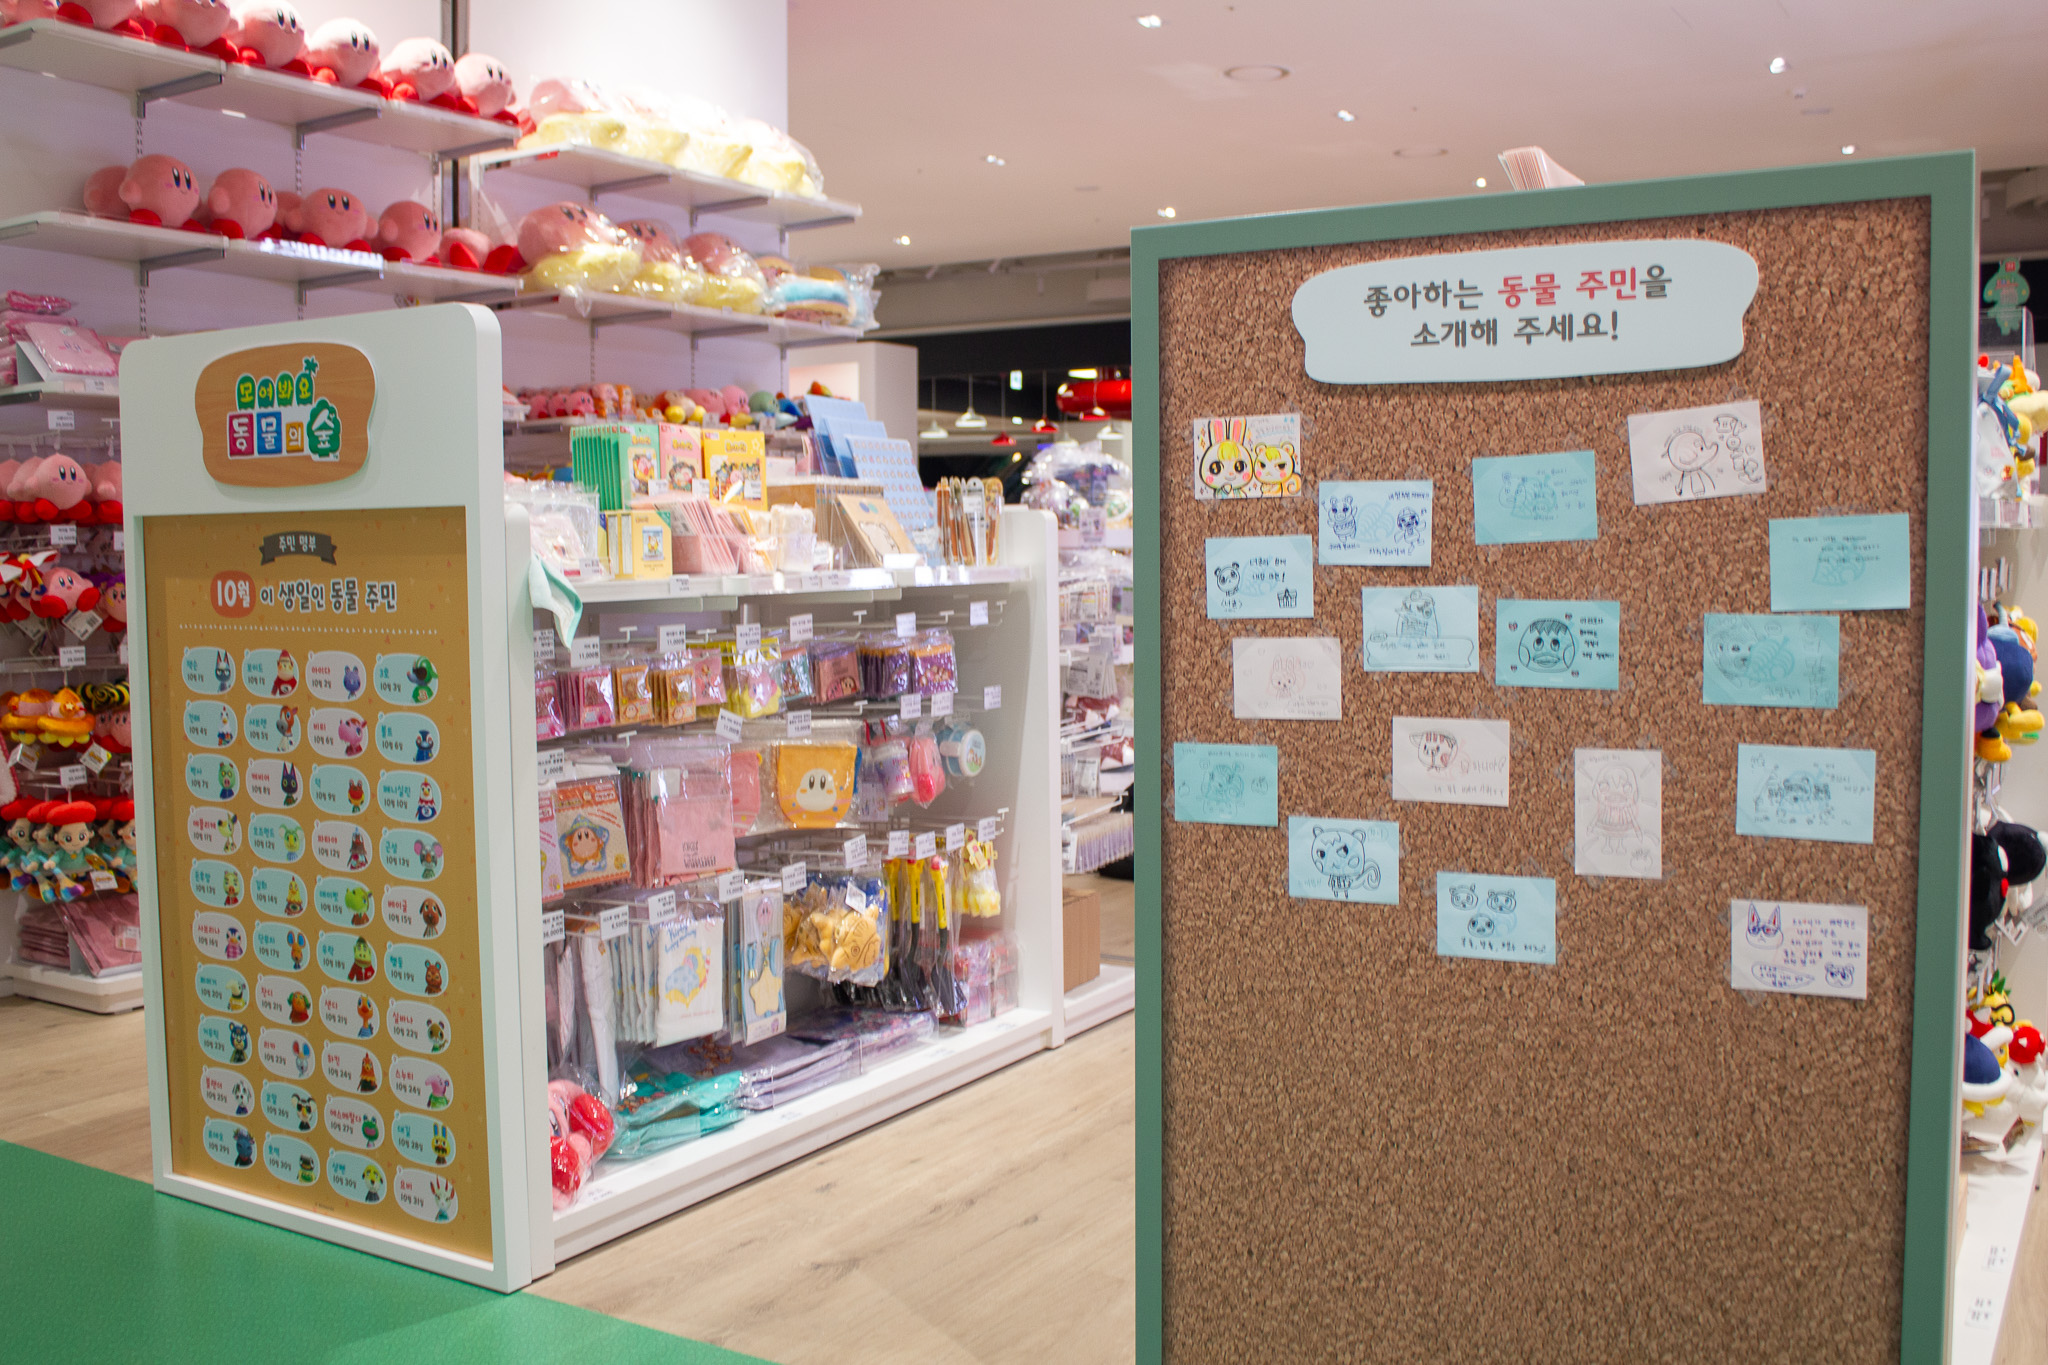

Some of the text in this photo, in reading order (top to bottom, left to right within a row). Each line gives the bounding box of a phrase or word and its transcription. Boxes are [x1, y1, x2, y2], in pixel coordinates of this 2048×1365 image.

[1364, 265, 1673, 318] 좋아하는 동물 주민을
[1410, 311, 1619, 348] 소개해 주세요!
[239, 377, 312, 403] 모여봐요
[232, 408, 336, 452] 동물의 숲
[279, 535, 316, 552] 주민 명부
[216, 577, 397, 615] 10월 이 생일인 동물 주민
[311, 666, 331, 675] 아이다
